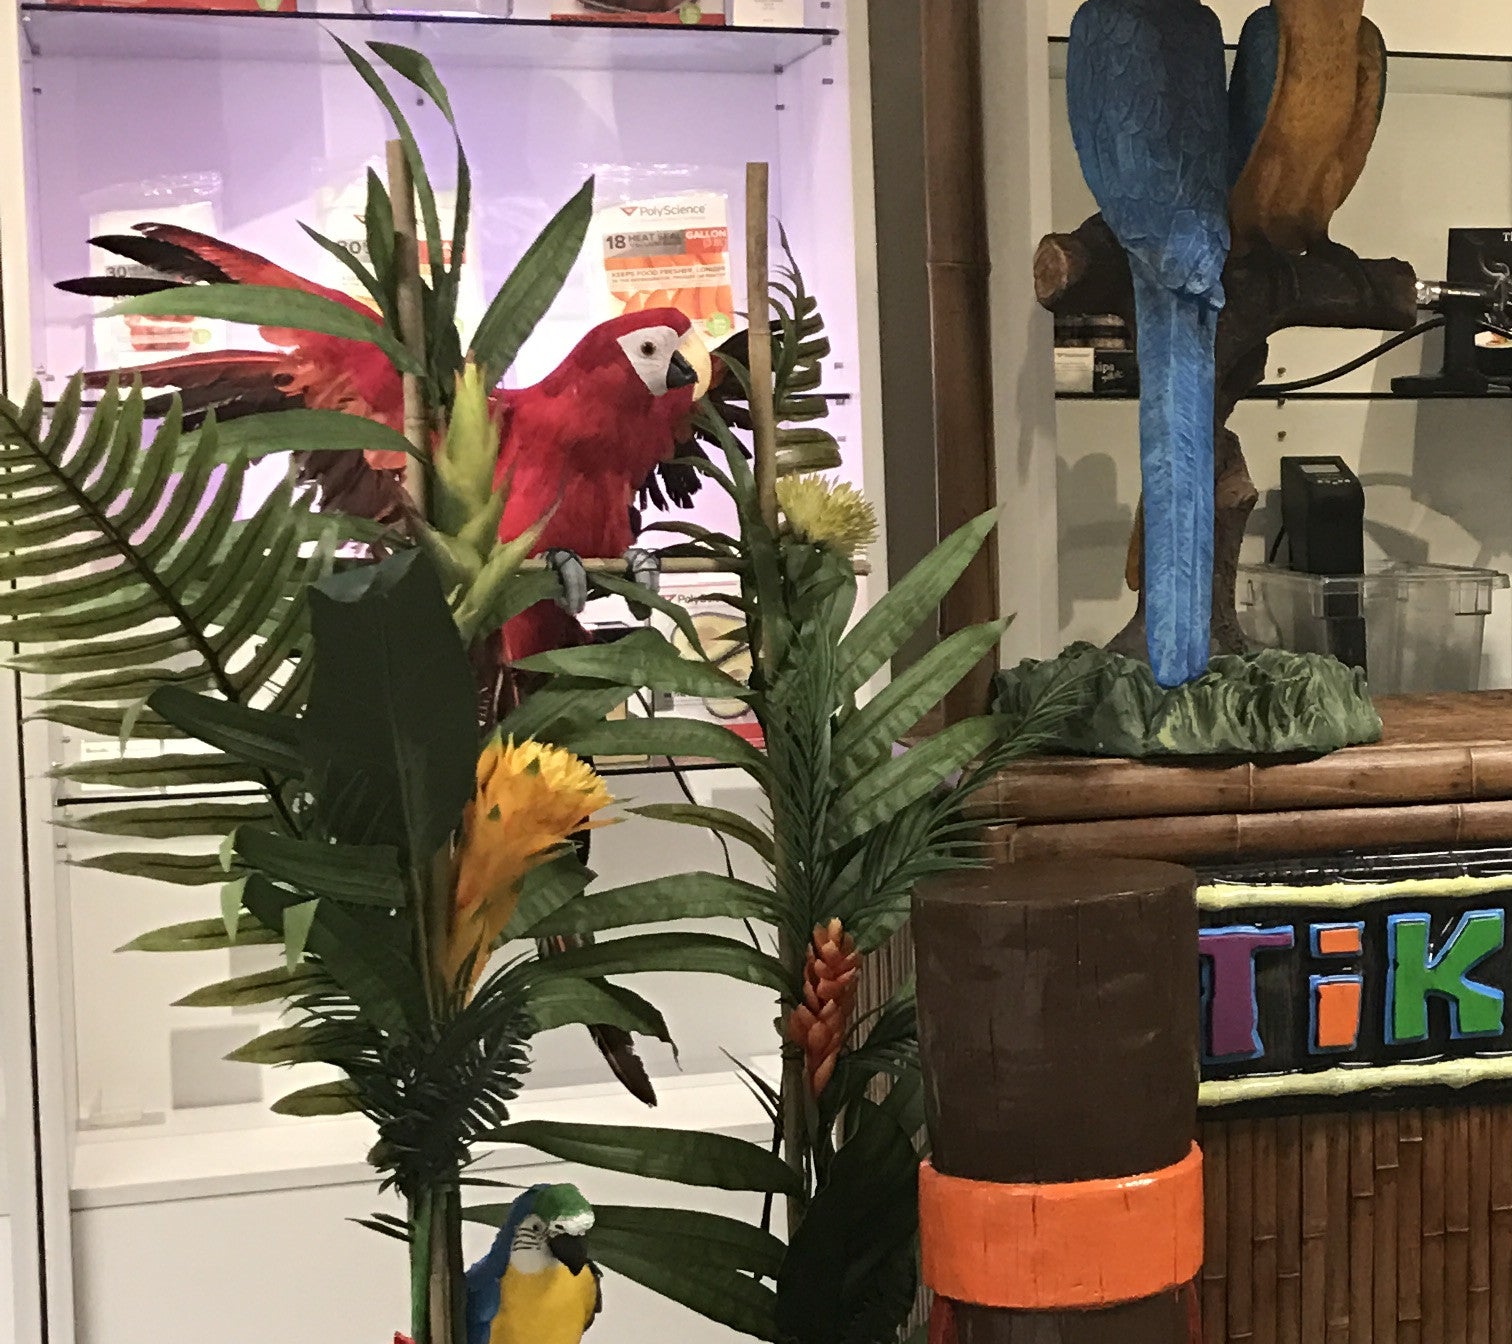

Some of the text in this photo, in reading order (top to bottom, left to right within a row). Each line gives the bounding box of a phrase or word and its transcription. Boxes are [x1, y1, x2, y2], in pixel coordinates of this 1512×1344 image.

[640, 204, 706, 217] PolyScience
[606, 235, 626, 249] 18
[685, 229, 727, 240] GALLON
